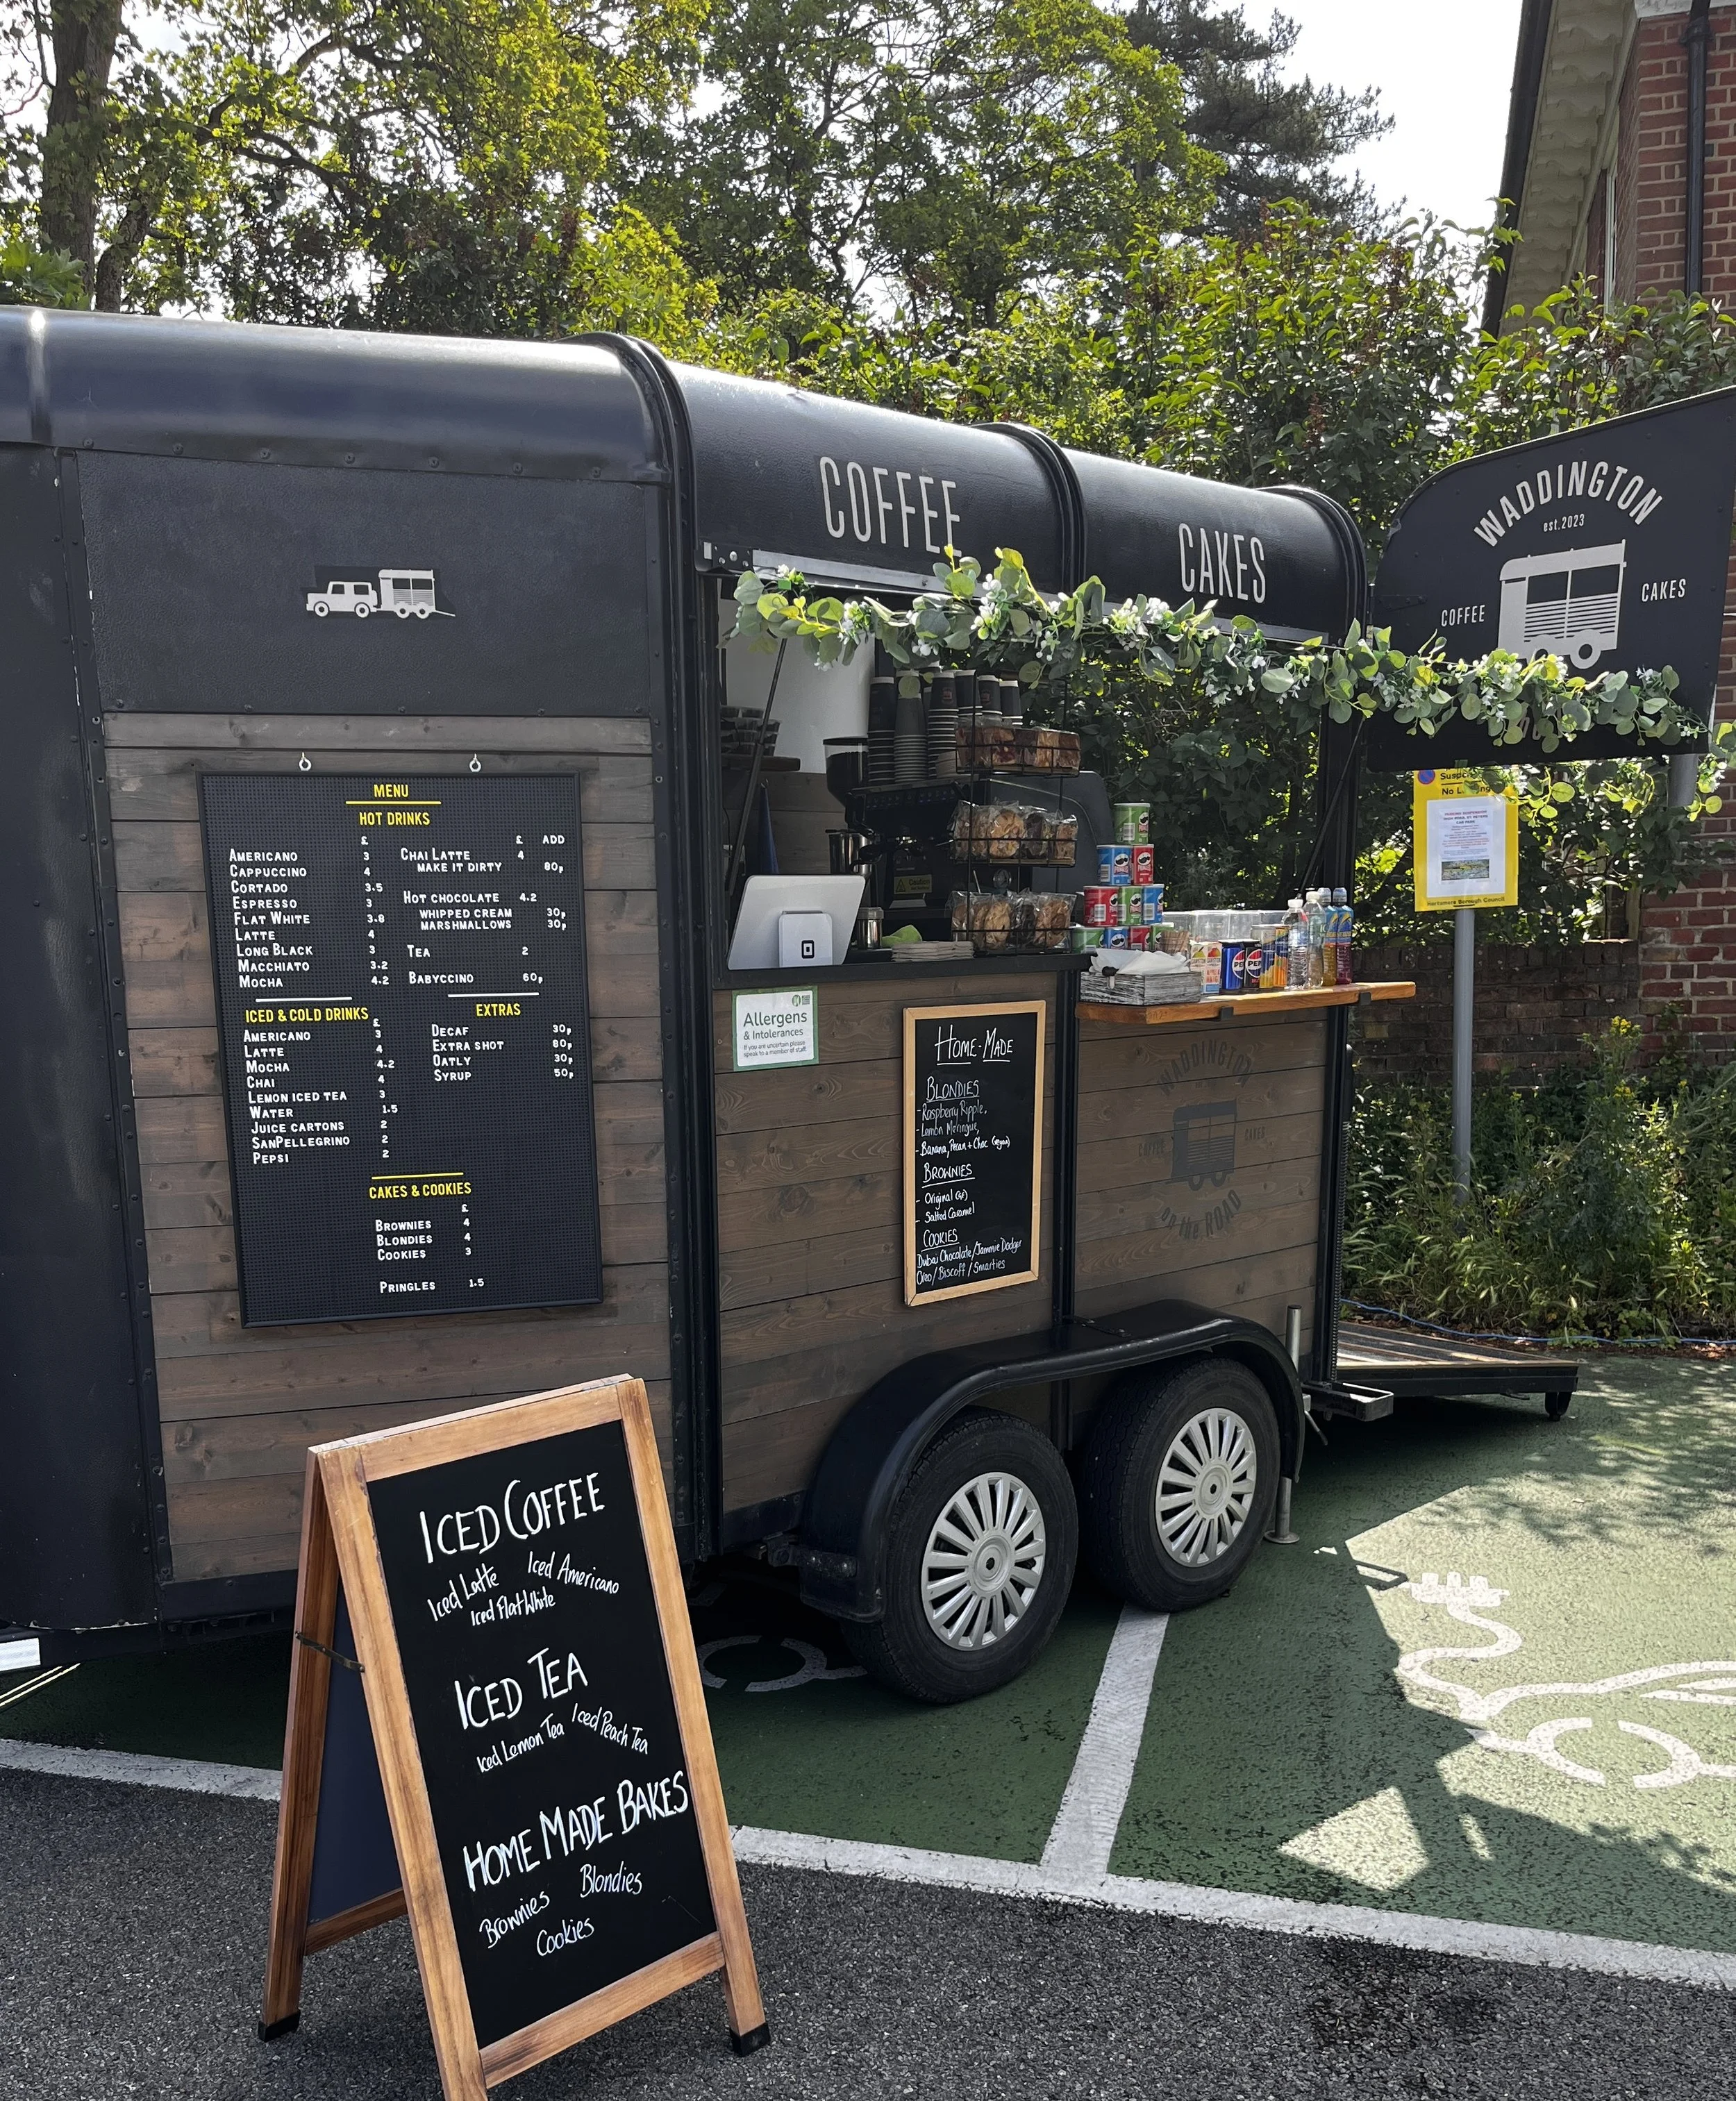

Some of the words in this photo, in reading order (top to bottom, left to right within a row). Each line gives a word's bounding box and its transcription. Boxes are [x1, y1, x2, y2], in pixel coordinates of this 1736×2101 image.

[819, 456, 962, 557] COFFEE
[1474, 461, 1663, 546] WADDINGTON
[1543, 514, 1585, 533] est.2023
[1178, 523, 1267, 603] CAKES
[1641, 578, 1687, 602] CAKES
[1441, 605, 1485, 627] COFFEE
[374, 784, 409, 798] MENU
[359, 812, 383, 826] HOT
[387, 812, 431, 826] DRINKS
[360, 835, 369, 846] £
[515, 835, 524, 845] £
[542, 835, 565, 844] ADD
[228, 848, 298, 862] AMERICANO
[363, 851, 370, 861] 3
[400, 847, 428, 862] CHAI
[431, 847, 471, 861] LATTE
[517, 850, 524, 860] 4
[229, 864, 307, 878] CAPPUCCINO
[363, 867, 371, 877] 4
[417, 862, 449, 873] MAKE
[452, 862, 464, 873] IT
[467, 862, 502, 872] DIRTY
[544, 861, 564, 874] 80p
[231, 880, 288, 894] CORTADO
[365, 882, 383, 893] 3.5
[232, 896, 297, 910] ESPRESSO
[366, 898, 372, 908] 3
[403, 890, 427, 905] HOT
[431, 892, 500, 904] CHOCOLATE
[519, 892, 537, 902] 4.2
[233, 912, 267, 926] FLAT
[269, 910, 310, 925] WHITE
[367, 914, 385, 923] 3.8
[419, 909, 471, 919] WHIPPED
[474, 907, 512, 919] CREAM
[546, 907, 566, 919] 30p
[420, 919, 512, 930] MARSHMALLOWS
[547, 919, 567, 931] 30p
[235, 927, 276, 941] LATTE
[367, 929, 375, 939] 4
[236, 943, 269, 957] LONG
[272, 942, 313, 956] BLACK
[369, 945, 376, 955] 3
[406, 944, 431, 958] TEA
[521, 946, 529, 955] 2
[237, 958, 310, 973] MACCHIATO
[370, 960, 388, 970] 3.2
[239, 974, 283, 988] MOCHA
[371, 976, 390, 985] 4.2
[408, 971, 474, 985] BABYCCINO
[522, 972, 543, 985] 60p
[245, 1009, 274, 1023] ICED
[277, 1009, 287, 1022] &
[289, 1007, 322, 1022] COLD
[325, 1007, 369, 1021] DRINKS
[476, 1003, 521, 1016] EXTRAS
[372, 1018, 381, 1028] £
[743, 1012, 807, 1027] Allergens
[243, 1029, 311, 1043] AMERICANO
[375, 1029, 382, 1039] 3
[431, 1023, 469, 1037] DECAF
[552, 1023, 571, 1036] 30p
[744, 1031, 750, 1040] &
[753, 1028, 803, 1039] Intolerances
[244, 1044, 285, 1058] LATTE
[376, 1044, 383, 1053] 4
[432, 1039, 471, 1052] EXTRA
[474, 1041, 504, 1050] SHOT
[552, 1039, 573, 1050] 80p
[246, 1060, 290, 1073] MOCHA
[376, 1059, 395, 1069] 4.2
[433, 1053, 471, 1067] OATLY
[554, 1053, 574, 1065] 30p
[433, 1069, 471, 1082] SYRUP
[553, 1068, 574, 1080] 50p
[1157, 1039, 1253, 1097] WADDINGTON
[247, 1075, 275, 1089] CHAI
[378, 1074, 385, 1084] 4
[926, 1076, 979, 1100] BLONDIES
[248, 1090, 289, 1104] LEMON
[292, 1091, 320, 1103] ICED
[323, 1091, 347, 1101] TEA
[378, 1089, 385, 1099] 3
[249, 1105, 294, 1119] WATER
[382, 1104, 399, 1114] 1.5
[922, 1103, 959, 1127] Raspberry
[251, 1121, 287, 1135] JUICE
[290, 1121, 344, 1132] CARTONS
[380, 1119, 387, 1129] 2
[921, 1123, 943, 1137] Lemon
[1244, 1126, 1265, 1141] CAKES
[251, 1135, 350, 1150] SANPELLEGRINO
[381, 1135, 389, 1144] 2
[949, 1139, 967, 1152] Pecan
[973, 1136, 989, 1149] Choc
[253, 1151, 289, 1165] PEPSI
[382, 1149, 390, 1158] 2
[923, 1162, 972, 1182] BROWNIES
[369, 1185, 408, 1199] CAKES
[411, 1185, 420, 1197] &
[422, 1182, 471, 1196] COOKIES
[925, 1189, 953, 1209] Original
[461, 1203, 469, 1213] £
[924, 1211, 946, 1223] Salted
[948, 1201, 975, 1218] Caramel
[1205, 1189, 1242, 1237] ROAD
[375, 1219, 432, 1232] BROWNIES
[462, 1218, 470, 1227] 4
[376, 1234, 433, 1247] BLONDIES
[464, 1232, 471, 1241] 4
[923, 1228, 958, 1248] COOKIES
[377, 1248, 426, 1262] COOKIES
[465, 1246, 471, 1256] 3
[917, 1254, 939, 1268] Dubai
[1000, 1237, 1022, 1254] Dodger
[379, 1281, 435, 1294] PRINGLES
[469, 1278, 485, 1288] 1.5
[420, 1505, 500, 1563] ICED
[505, 1473, 605, 1539] COFFEE
[528, 1551, 555, 1578] Iced
[557, 1554, 619, 1593] Americano
[428, 1577, 465, 1621] Iced
[460, 1564, 502, 1602] Latte
[470, 1601, 495, 1626] Iced
[496, 1593, 524, 1619] Flat
[523, 1587, 556, 1615] White
[455, 1678, 522, 1730] ICED
[527, 1648, 587, 1698] TEA
[572, 1703, 602, 1731] Iced
[600, 1711, 628, 1746] Peach
[632, 1727, 647, 1754] Tea
[477, 1747, 503, 1773] Iced
[501, 1733, 544, 1761] Lemon
[540, 1714, 565, 1739] Tea
[463, 1830, 540, 1892] HOME
[540, 1796, 612, 1859] MADE
[617, 1771, 687, 1834] BAKES
[581, 1861, 642, 1898] Blondies
[479, 1891, 550, 1948] Brownies
[537, 1918, 595, 1957] Cookies
